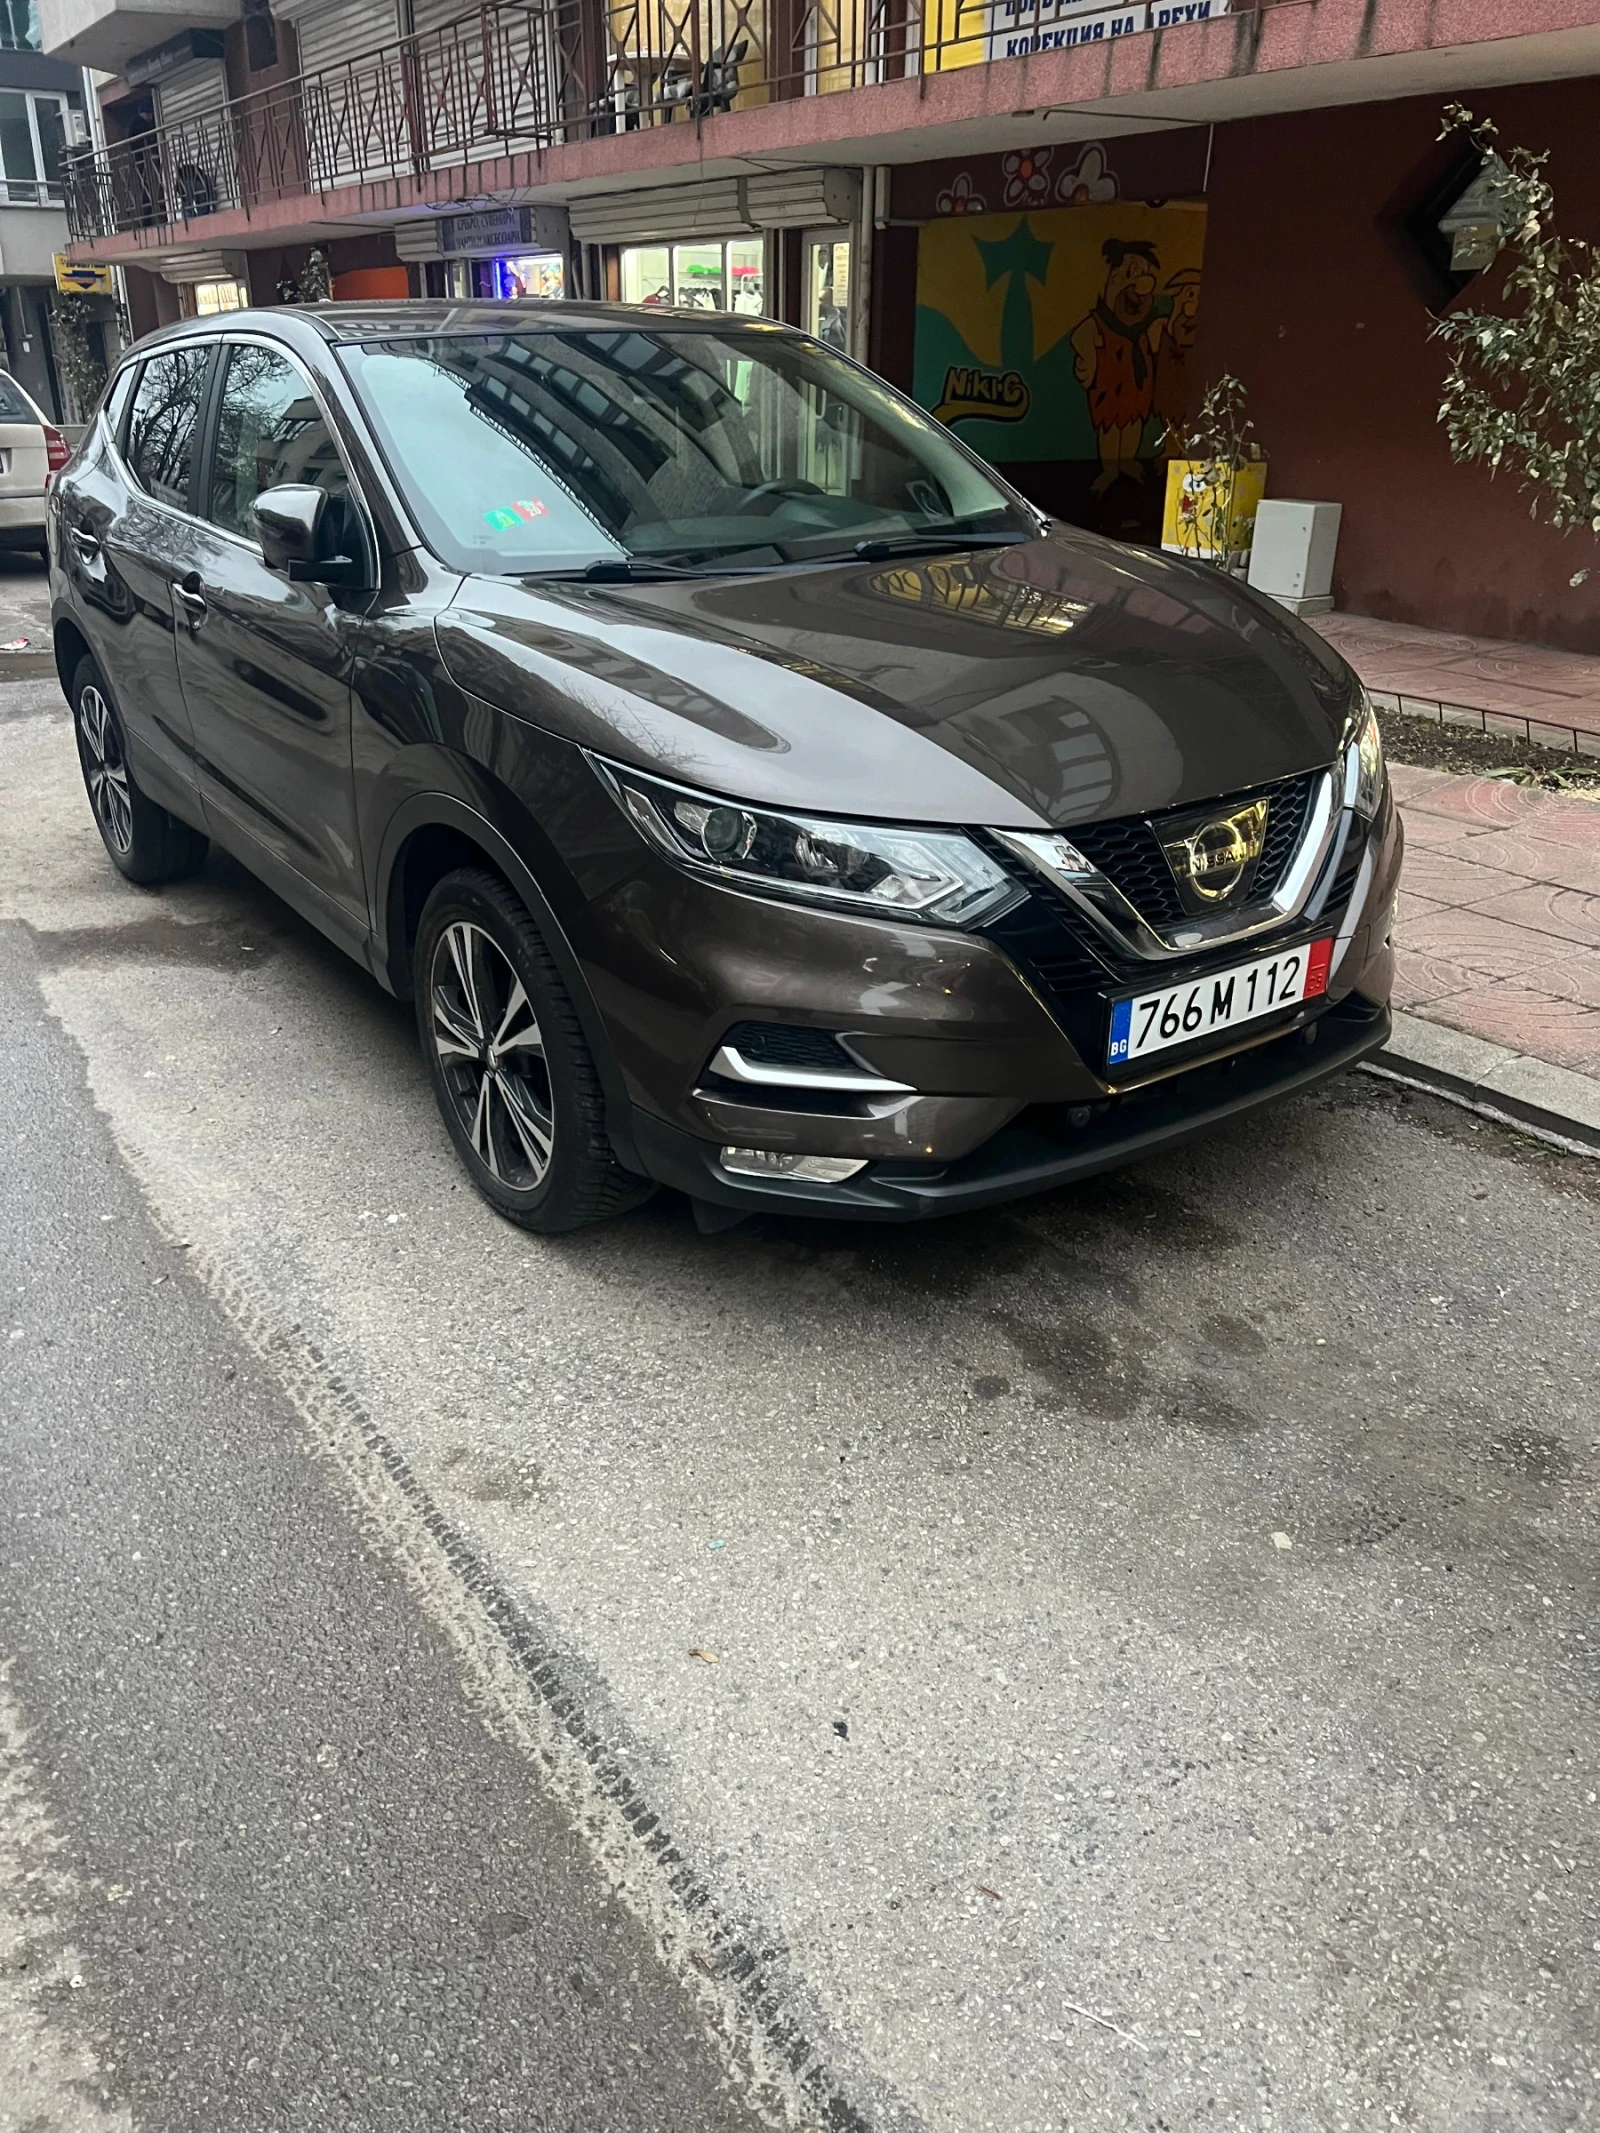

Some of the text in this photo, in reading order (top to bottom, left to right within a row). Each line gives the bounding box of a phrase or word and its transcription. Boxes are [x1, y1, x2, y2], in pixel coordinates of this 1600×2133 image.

[1112, 16, 1134, 38] НА
[1110, 1040, 1128, 1057] BG
[1135, 986, 1203, 1049] 766
[1210, 976, 1235, 1025] M
[1247, 956, 1301, 1012] 112
